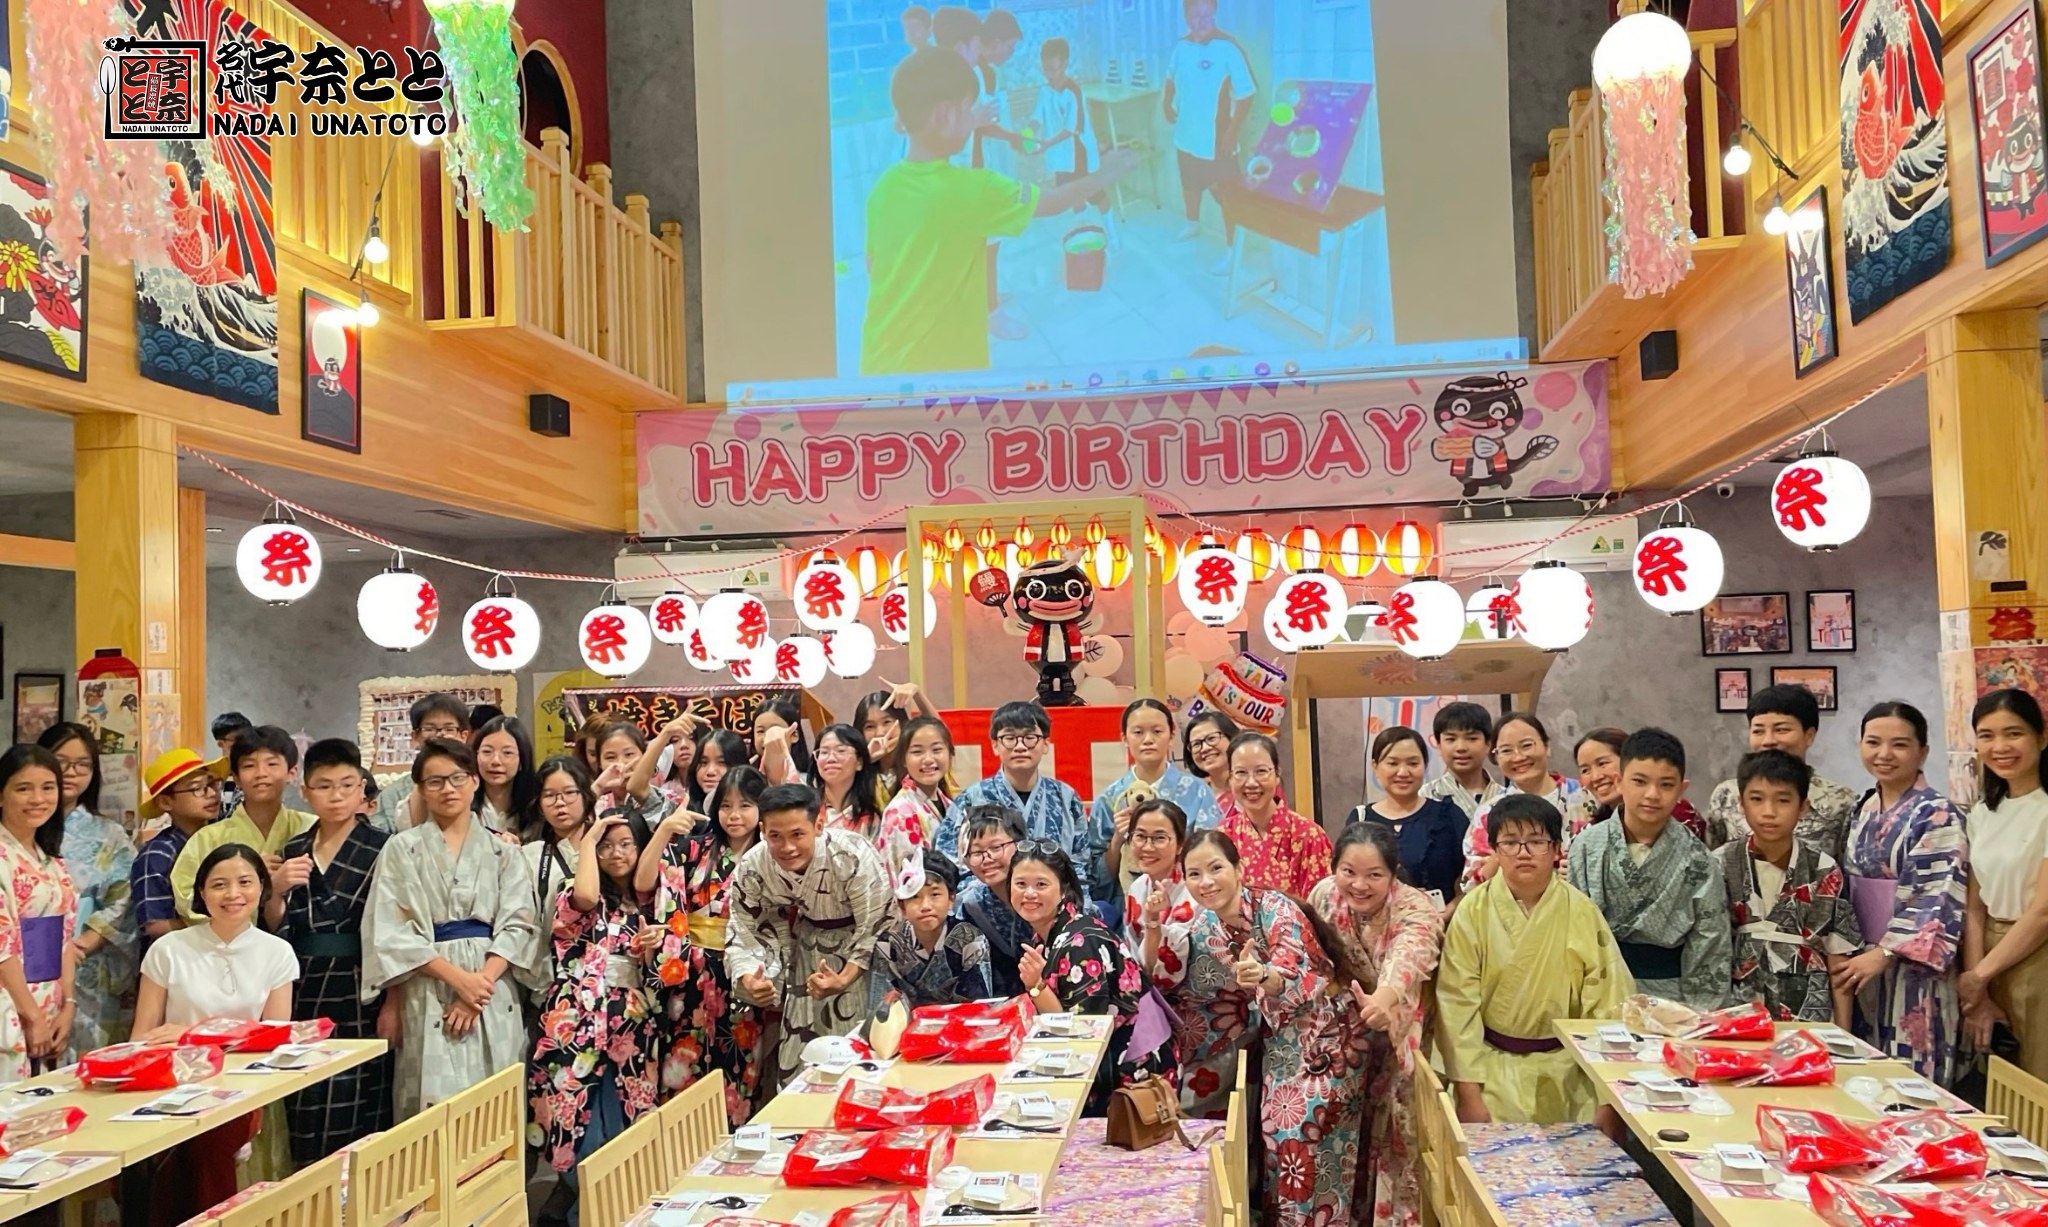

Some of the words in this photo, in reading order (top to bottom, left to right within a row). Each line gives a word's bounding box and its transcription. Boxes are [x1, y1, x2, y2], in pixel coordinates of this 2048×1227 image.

[690, 428, 966, 507] HAPPY
[985, 403, 1427, 495] BIRTHDAY
[1775, 467, 1827, 531] 祭
[262, 531, 312, 586] 祭
[1194, 556, 1238, 605] 祭
[1637, 536, 1688, 597] 祭
[656, 599, 686, 633] 祭
[804, 571, 845, 619] 祭
[1286, 581, 1330, 632] 祭
[471, 606, 516, 658] 祭
[584, 614, 627, 664] 祭
[776, 643, 800, 680] 祭
[1243, 663, 1273, 689] YAY
[1237, 698, 1275, 723] YOUR
